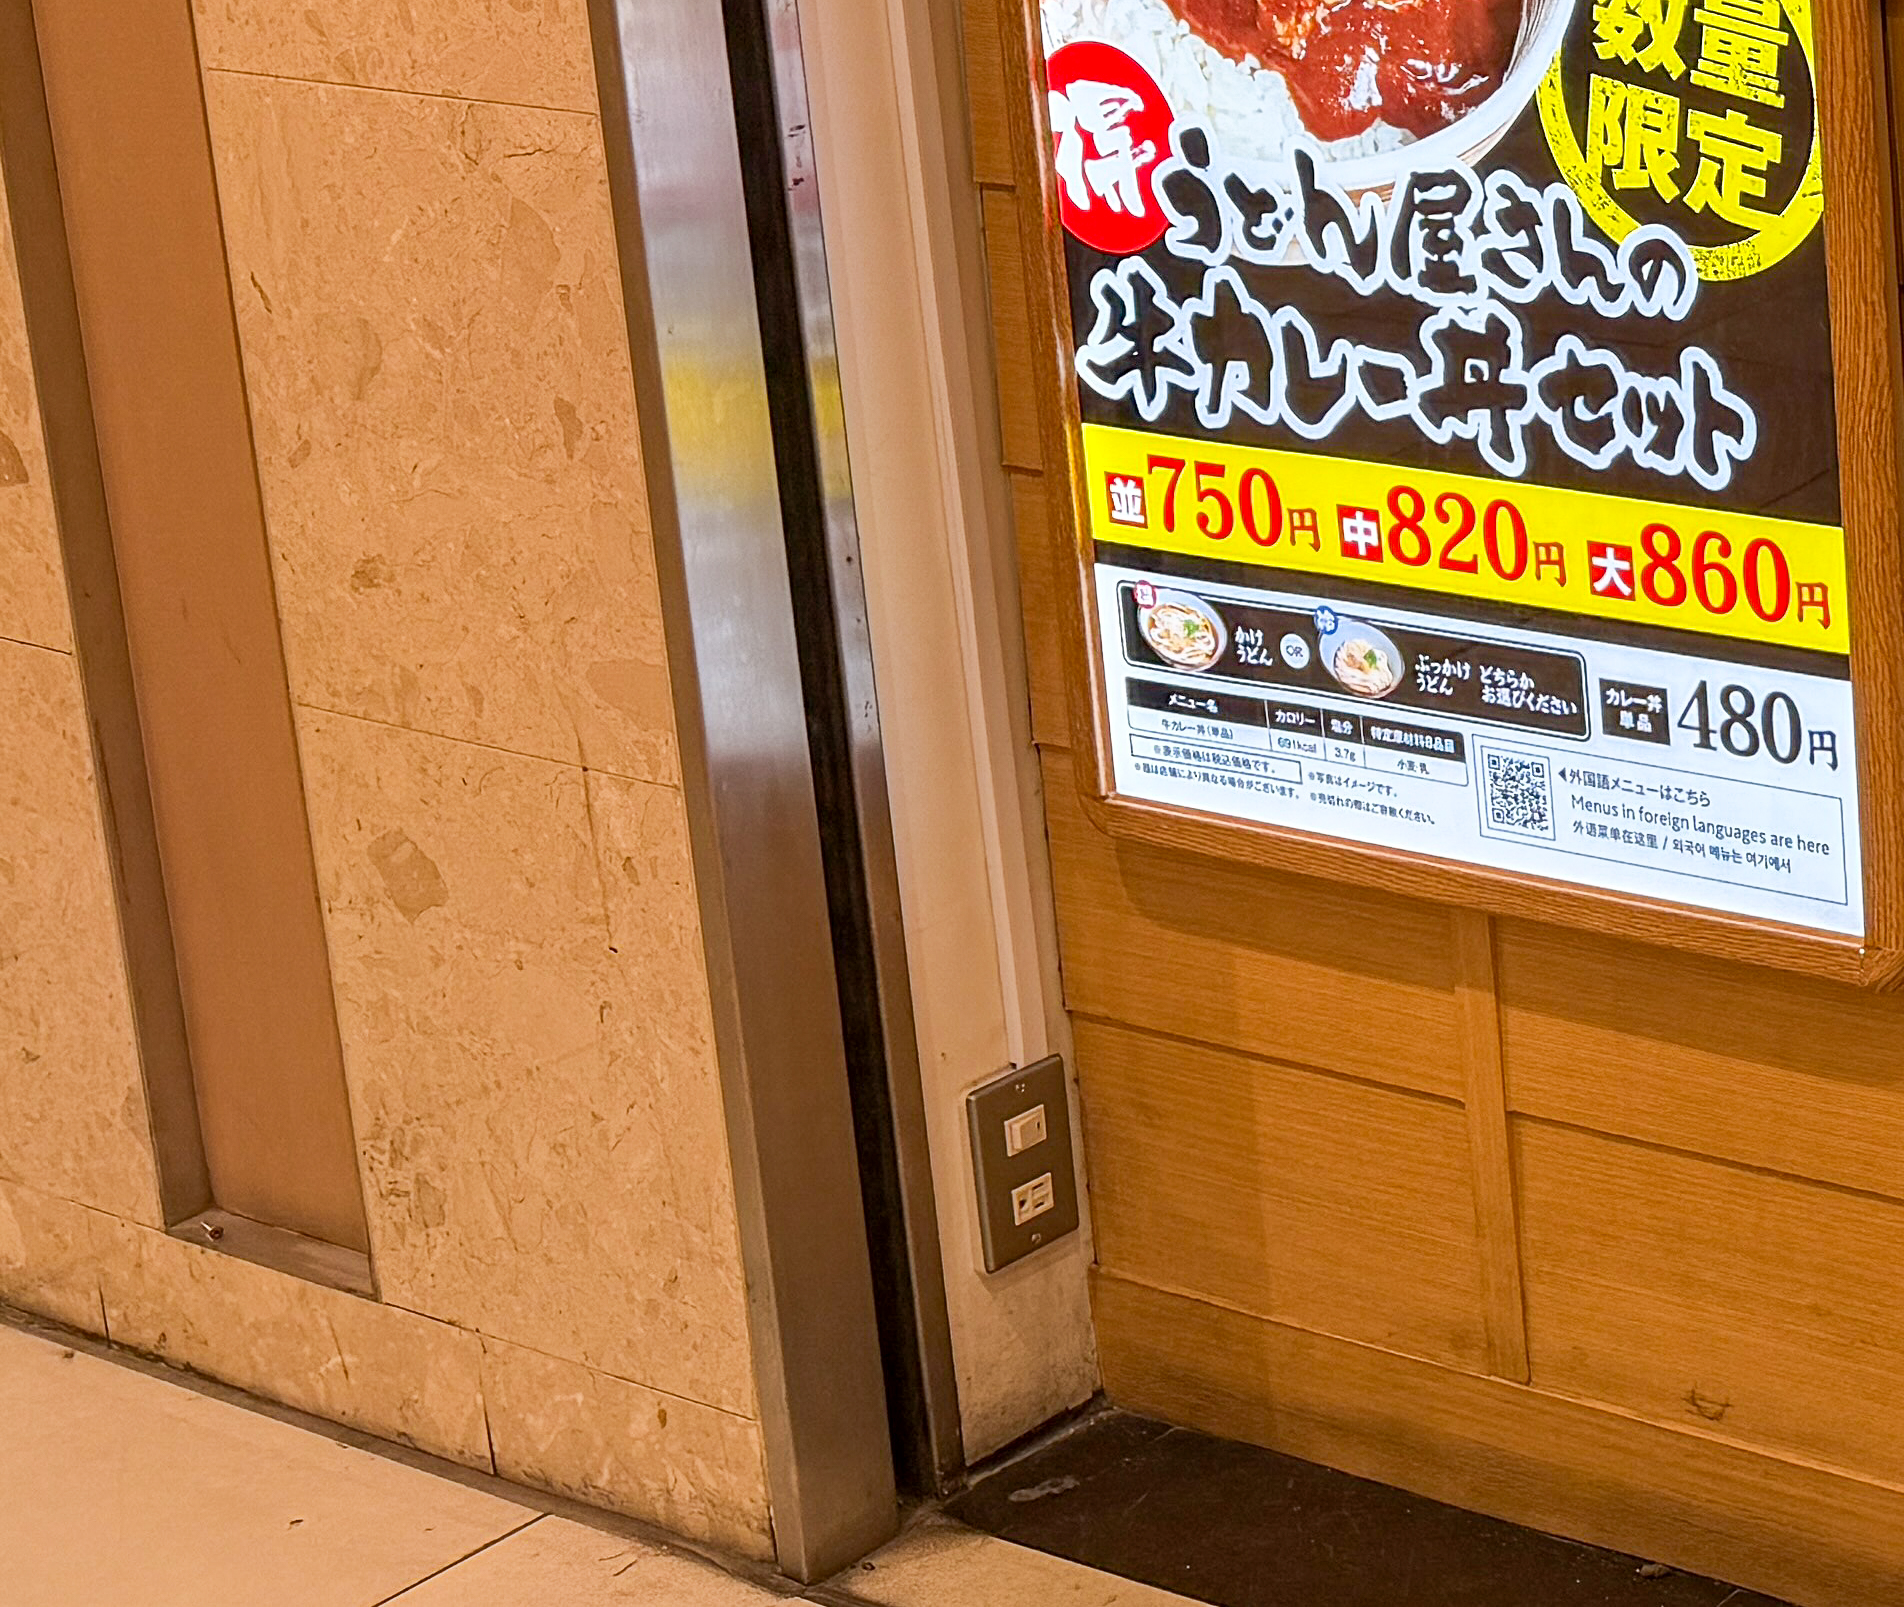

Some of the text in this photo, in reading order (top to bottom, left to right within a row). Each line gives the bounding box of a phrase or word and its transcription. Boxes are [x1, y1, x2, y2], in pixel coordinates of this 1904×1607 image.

[1048, 77, 1156, 220] 得
[1585, 75, 1785, 224] 限定
[1160, 124, 1696, 319] うどん屋さんの
[1077, 271, 1756, 488] 牛カレー丼セット
[1235, 627, 1264, 646] かけ
[1236, 647, 1273, 666] うどん
[1286, 645, 1304, 657] OR
[1415, 655, 1470, 678] ぶっかけ
[1479, 665, 1535, 689] どちらか
[1416, 675, 1453, 696] うどん
[1482, 687, 1577, 715] お選びください
[1605, 688, 1662, 714] カレー丼
[1275, 710, 1315, 726] カロリー
[1677, 680, 1838, 771] 480円
[1569, 769, 1711, 807] 外国語メニューはこちら
[1572, 794, 1830, 855] Menus in foreign languages are here
